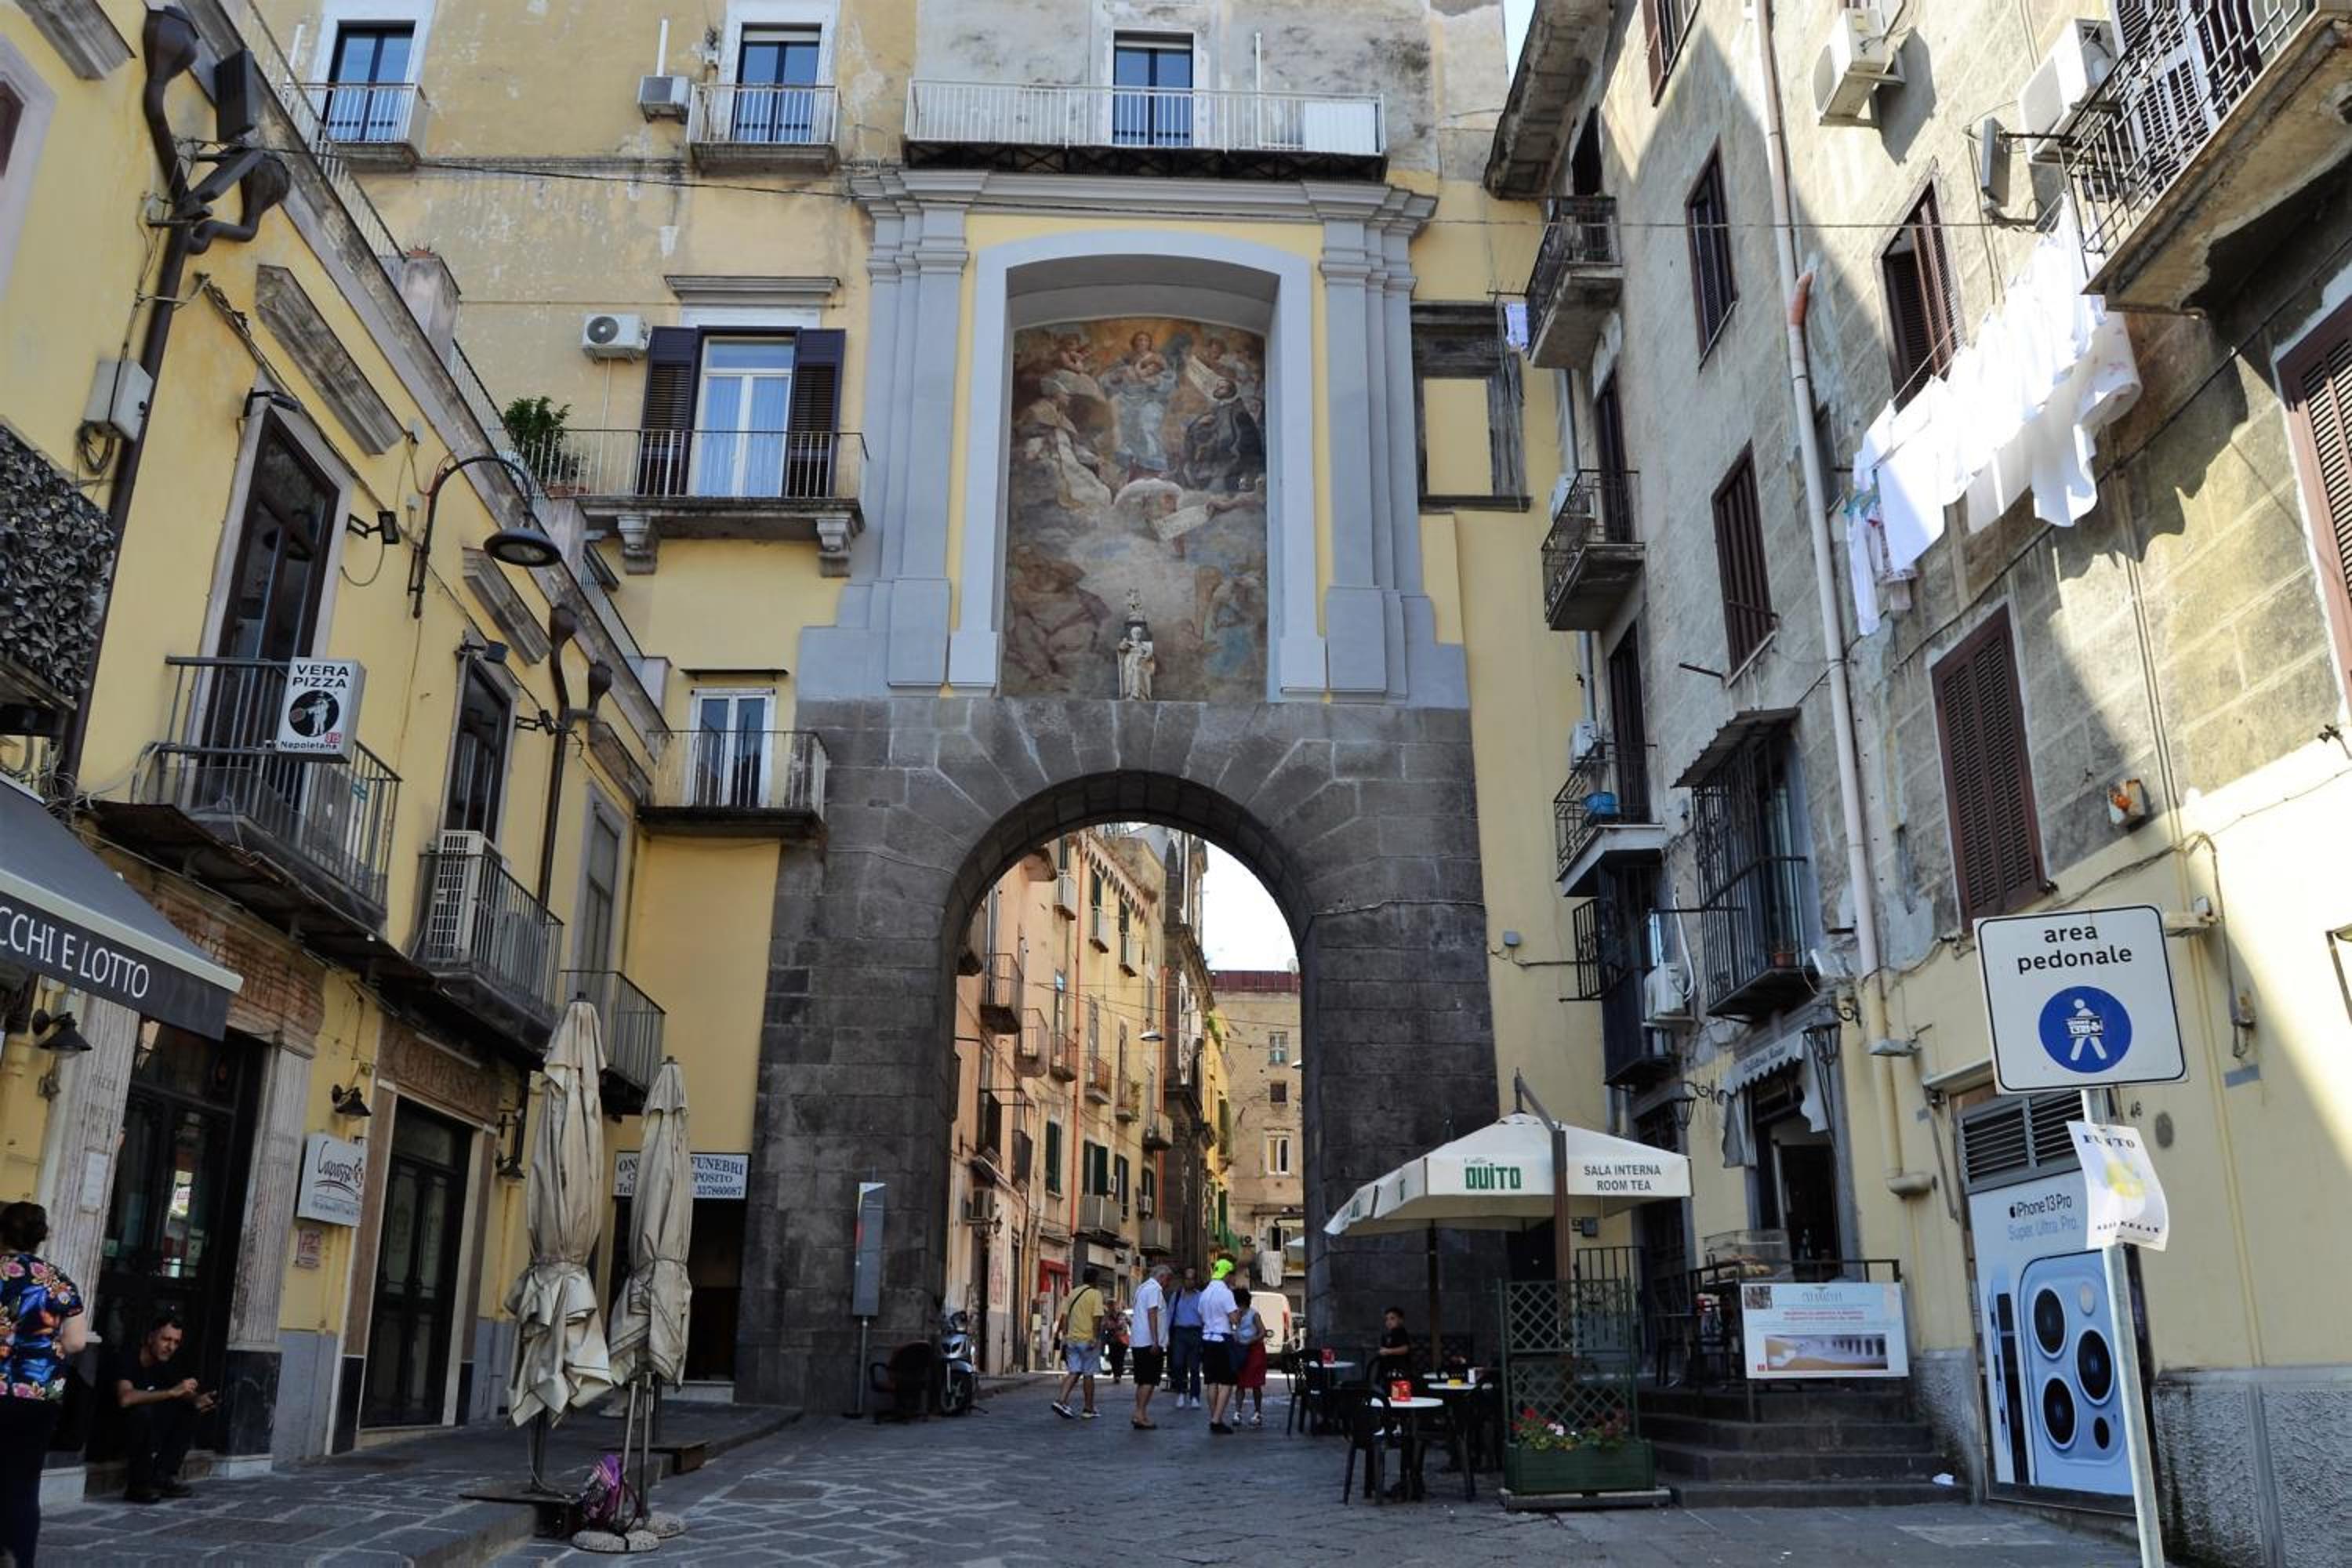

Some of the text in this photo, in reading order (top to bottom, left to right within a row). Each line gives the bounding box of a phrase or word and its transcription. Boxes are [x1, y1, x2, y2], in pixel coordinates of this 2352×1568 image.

[296, 664, 349, 677] VERA
[292, 677, 347, 688] PIZZA
[2044, 925, 2099, 943] area
[61, 932, 76, 971] E
[79, 940, 150, 999] LOTTO
[2017, 945, 2133, 975] pedonale
[1584, 1164, 1662, 1176] SALA INTERNA
[1597, 1180, 1652, 1191] ROOM TEA
[2016, 1193, 2072, 1218] iPhone 13 Pro
